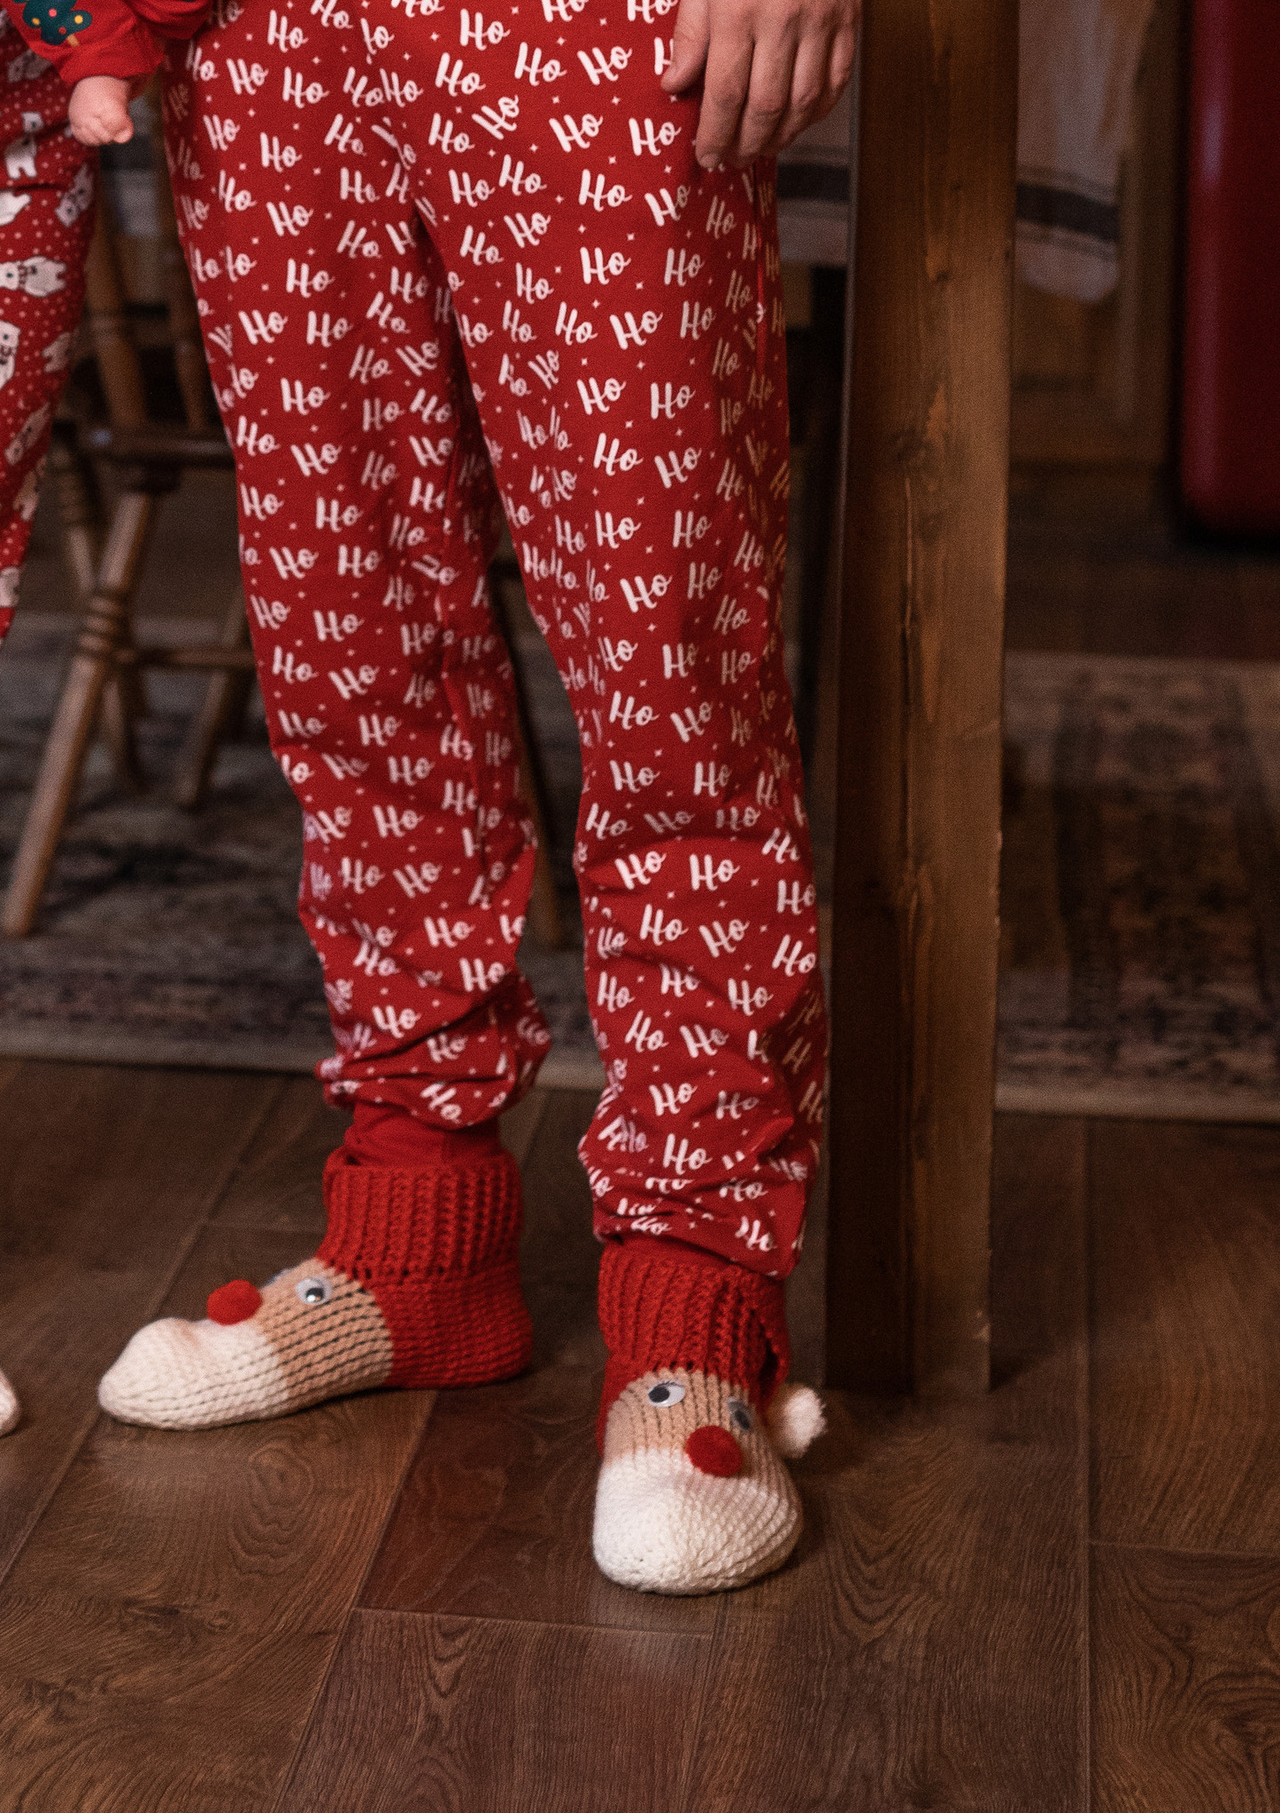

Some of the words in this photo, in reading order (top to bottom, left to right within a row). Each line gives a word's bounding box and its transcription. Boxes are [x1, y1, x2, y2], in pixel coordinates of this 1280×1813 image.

[267, 10, 307, 52] Ho
[460, 9, 510, 50] Ho
[226, 59, 268, 95] Ho
[435, 52, 485, 96] Ho
[514, 42, 566, 86] Ho
[577, 46, 632, 85] Ho
[282, 67, 328, 108] Ho
[379, 68, 423, 107] Ho
[203, 115, 239, 151] Ho
[428, 113, 474, 154] Ho
[472, 96, 519, 140] Ho
[549, 114, 603, 152] Ho
[629, 118, 680, 156] Ho
[260, 132, 301, 172] Ho
[219, 170, 255, 212] Ho
[448, 169, 494, 207] Ho
[499, 154, 546, 196] Ho
[579, 169, 631, 211] Ho
[266, 202, 313, 236] Ho
[644, 184, 690, 226] Ho
[706, 196, 735, 238] Ho
[337, 220, 379, 258] Ho
[460, 225, 502, 265] Ho
[504, 212, 551, 248] Ho
[286, 259, 332, 298] Ho
[516, 263, 553, 304] Ho
[580, 247, 630, 285] Ho
[664, 249, 702, 286] Ho
[238, 310, 287, 344] Ho
[306, 311, 349, 347] Ho
[366, 292, 406, 332] Ho
[502, 300, 535, 342] Ho
[555, 302, 596, 345] Ho
[609, 311, 662, 350] Ho
[680, 301, 712, 339] Ho
[349, 345, 390, 384] Ho
[396, 342, 437, 376] Ho
[712, 340, 739, 375] Ho
[281, 378, 328, 415] Ho
[363, 399, 402, 431] Ho
[577, 378, 626, 415] Ho
[650, 382, 693, 419] Ho
[236, 416, 278, 456] Ho
[593, 433, 642, 476] Ho
[291, 443, 340, 476] Ho
[362, 451, 395, 490] Ho
[654, 448, 700, 488] Ho
[241, 484, 283, 520] Ho
[316, 497, 360, 532] Ho
[502, 493, 533, 527] Ho
[391, 515, 425, 547] Ho
[555, 515, 585, 554] Ho
[595, 511, 640, 549] Ho
[672, 510, 708, 548] Ho
[269, 547, 317, 579] Ho
[338, 545, 379, 577] Ho
[251, 596, 290, 629] Ho
[620, 574, 671, 613] Ho
[313, 610, 362, 641] Ho
[714, 595, 750, 634] Ho
[272, 646, 316, 683] Ho
[599, 637, 637, 672] Ho
[662, 642, 698, 679] Ho
[721, 650, 756, 684] Ho
[329, 665, 378, 699] Ho
[609, 691, 657, 730] Ho
[359, 714, 399, 746] Ho
[388, 756, 432, 785] Ho
[610, 760, 658, 792] Ho
[373, 805, 422, 837] Ho
[585, 803, 627, 839] Ho
[340, 857, 383, 894] Ho
[393, 862, 440, 897] Ho
[615, 851, 666, 889] Ho
[689, 854, 739, 891] Ho
[424, 917, 473, 947] Ho
[640, 904, 686, 945] Ho
[699, 919, 748, 957] Ho
[772, 935, 816, 976] Ho
[459, 958, 505, 992] Ho
[597, 972, 633, 1012] Ho
[728, 978, 772, 1016] Ho
[372, 1005, 419, 1038] Ho
[625, 1011, 666, 1052] Ho
[680, 1025, 726, 1058] Ho
[421, 1083, 461, 1122] Ho
[649, 1083, 696, 1116] Ho
[662, 1133, 712, 1175] Ho
